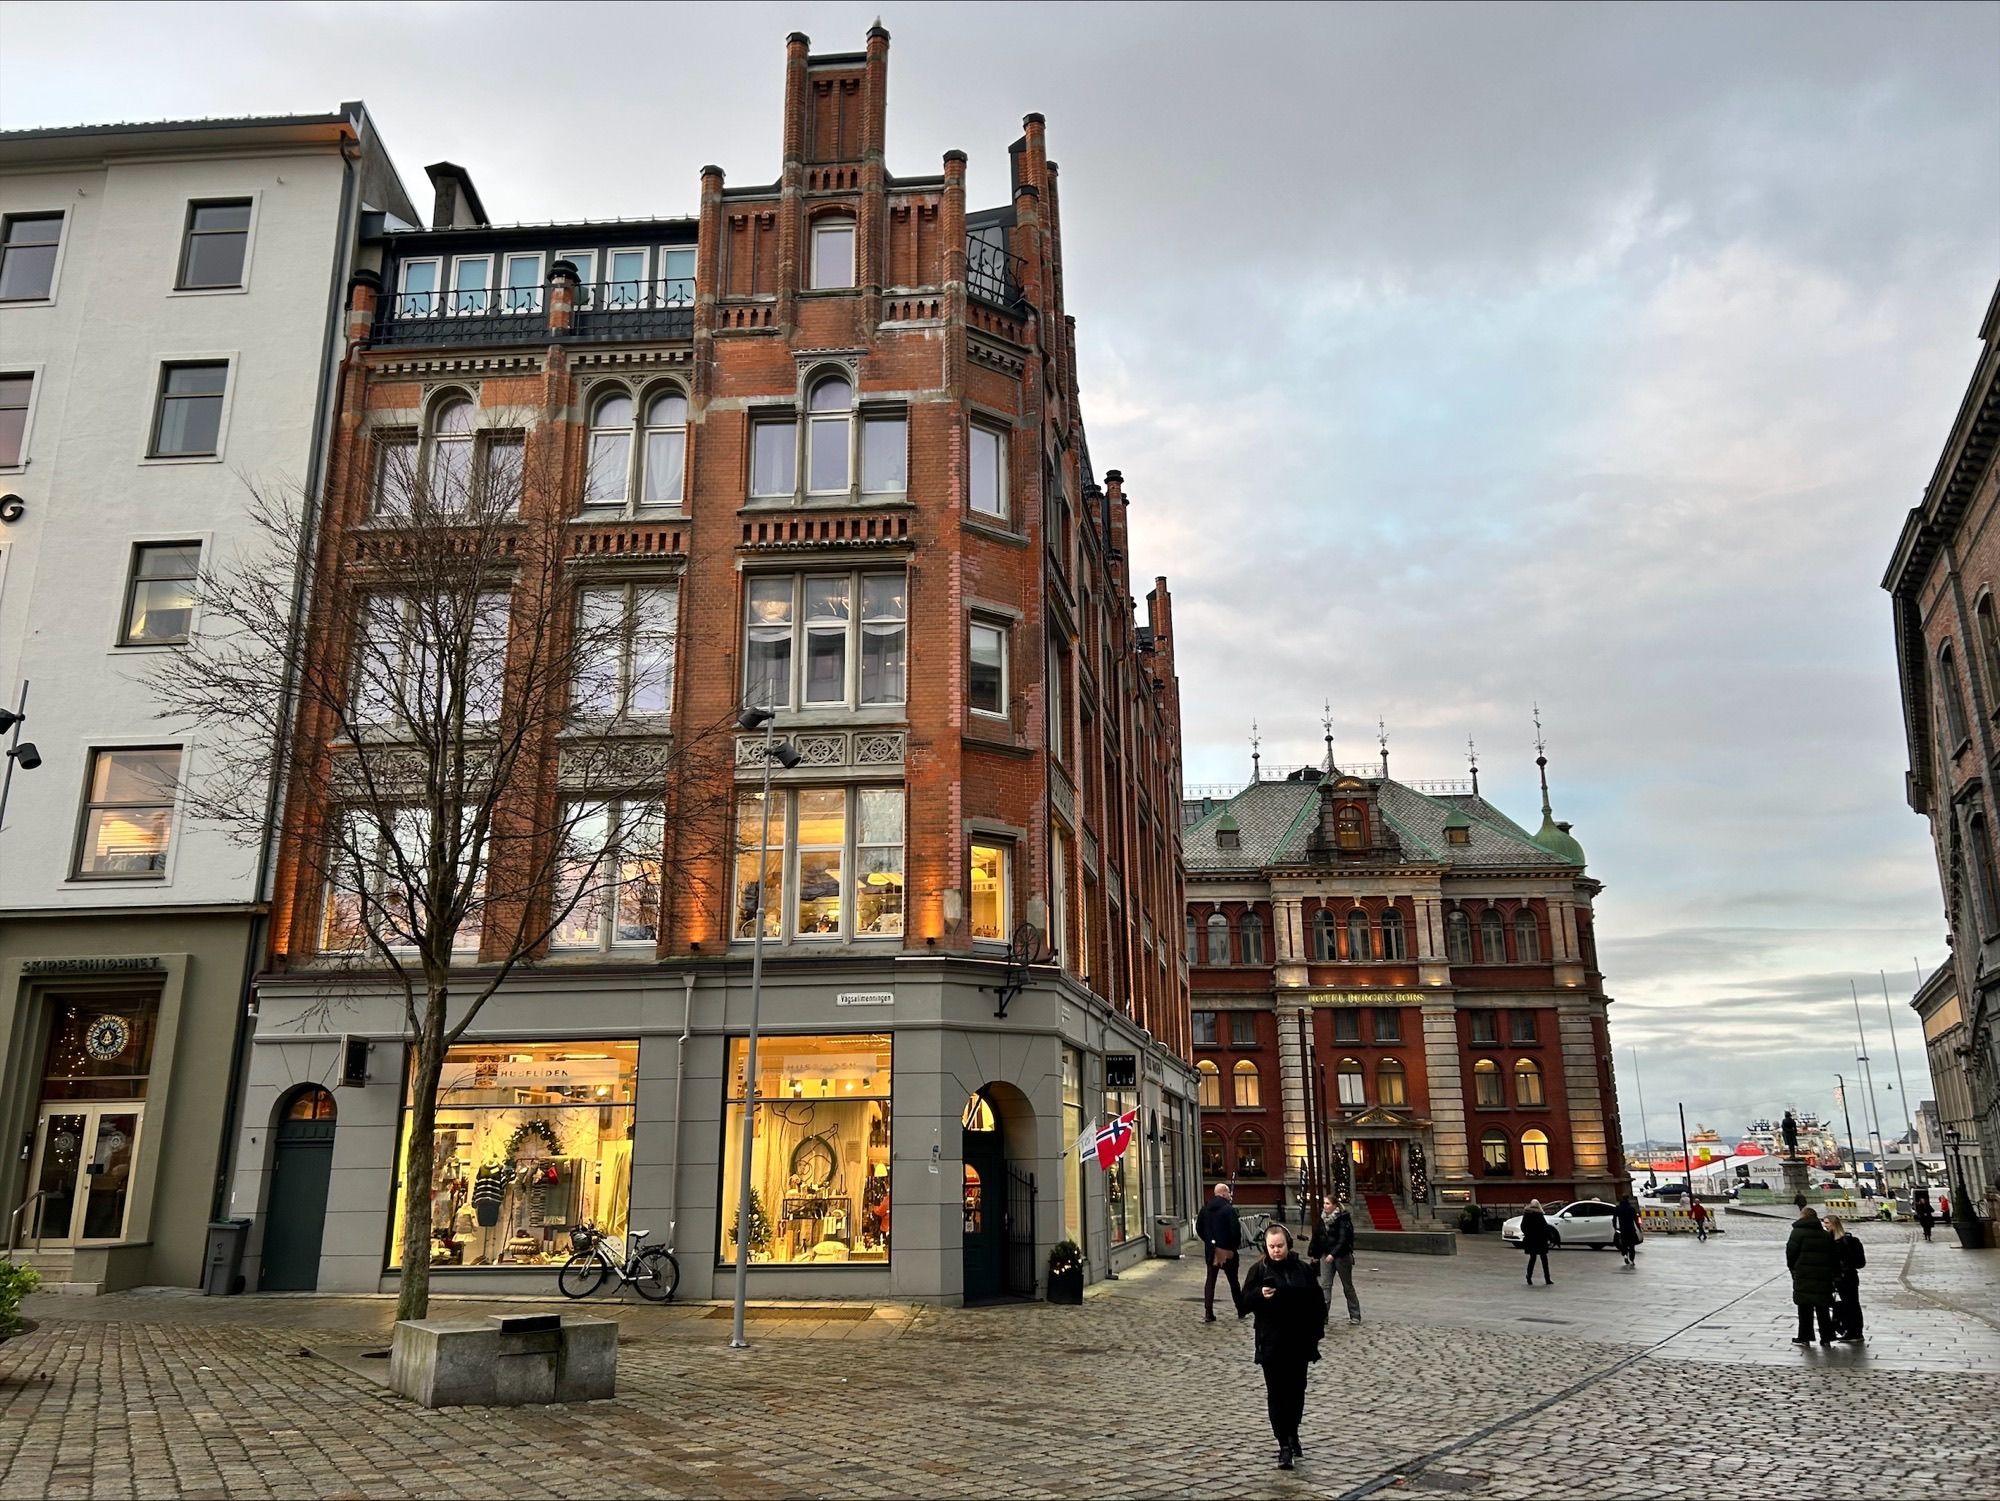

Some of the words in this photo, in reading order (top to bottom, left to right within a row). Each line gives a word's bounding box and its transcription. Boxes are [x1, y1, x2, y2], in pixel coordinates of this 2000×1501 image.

[0, 494, 24, 522] G
[1308, 992, 1343, 1003] HOTEL
[1347, 991, 1392, 1003] BERGEN
